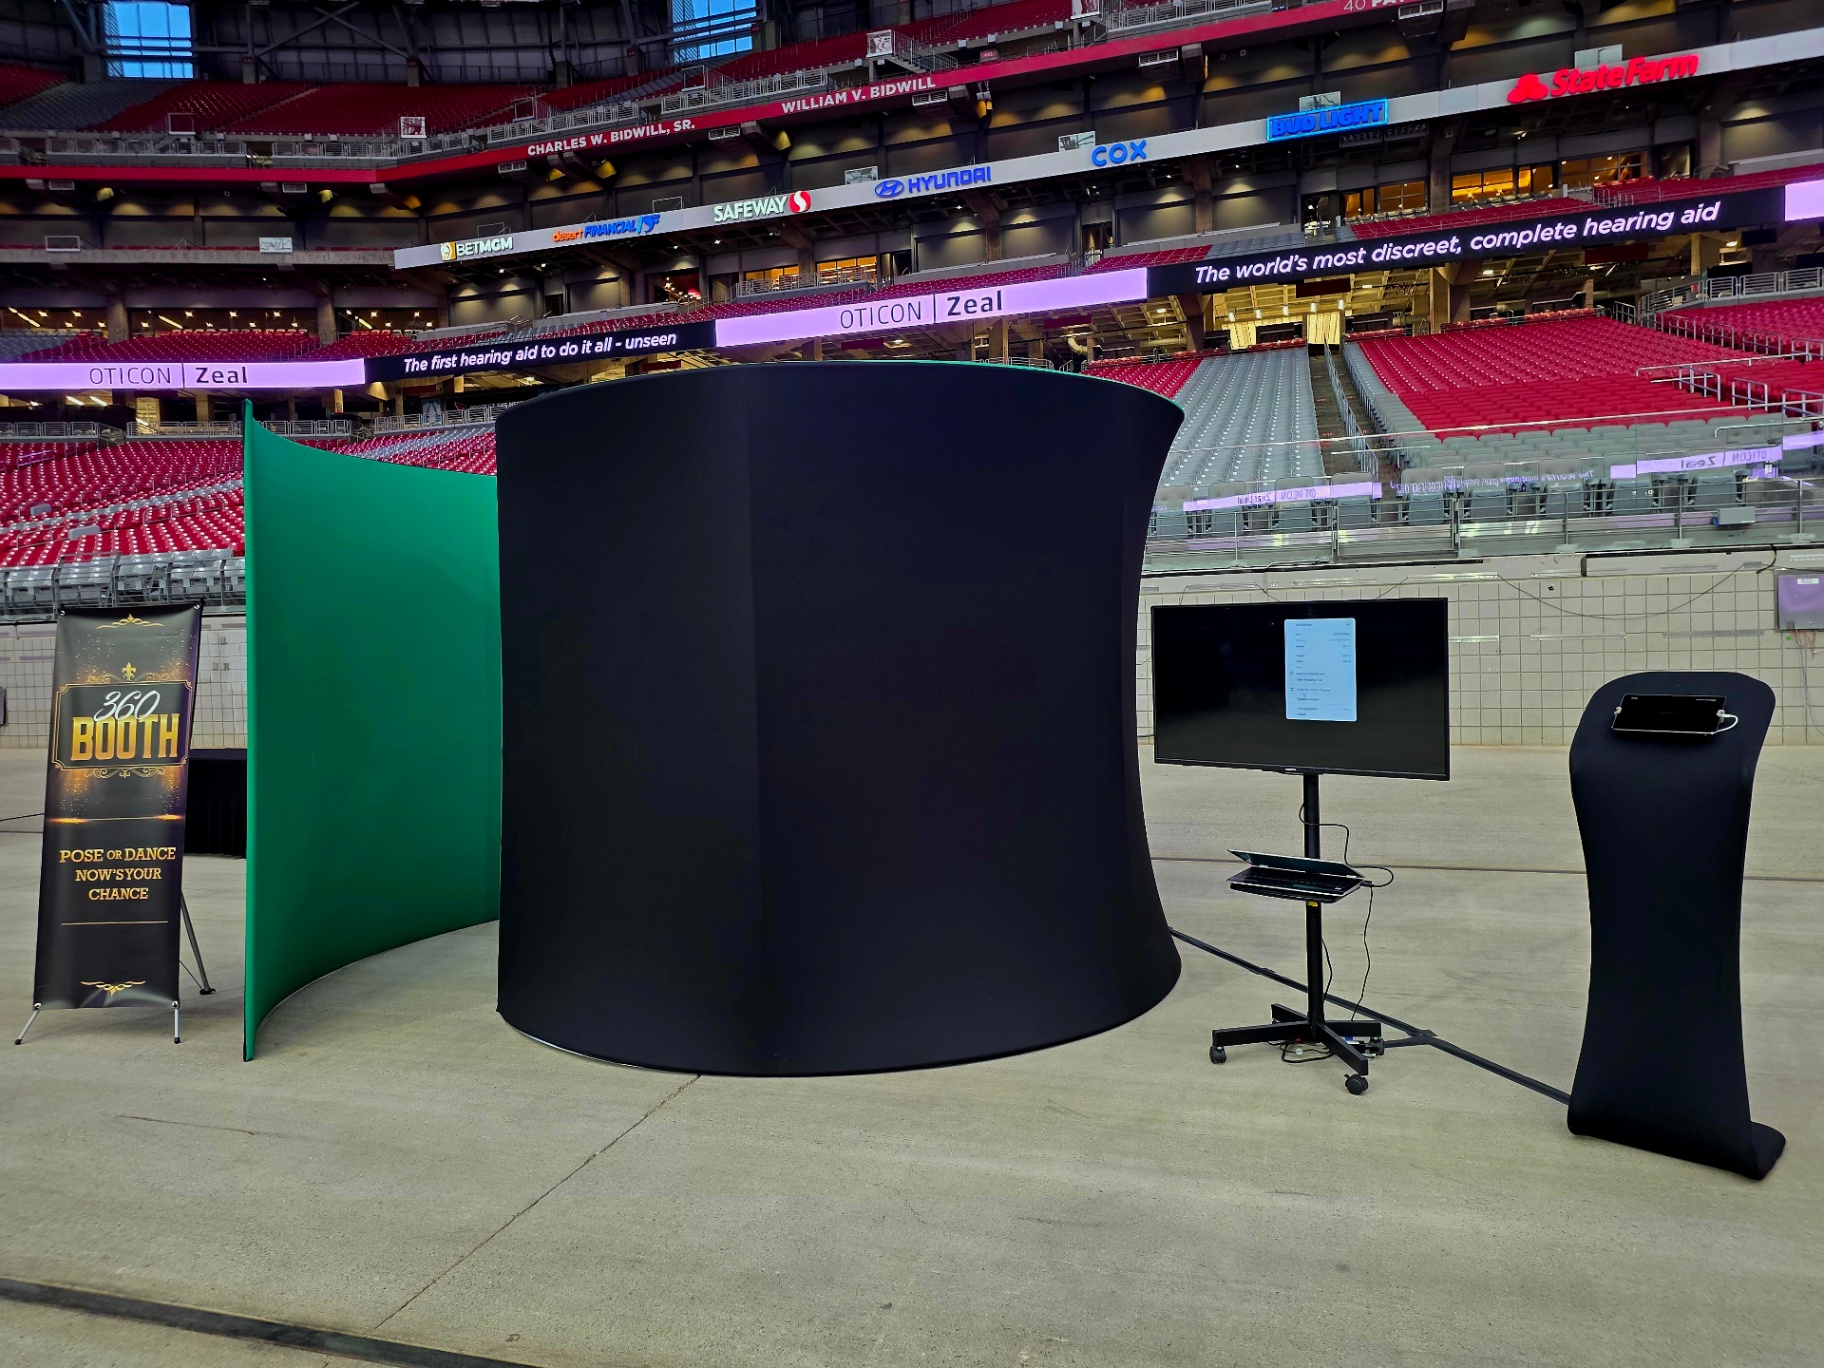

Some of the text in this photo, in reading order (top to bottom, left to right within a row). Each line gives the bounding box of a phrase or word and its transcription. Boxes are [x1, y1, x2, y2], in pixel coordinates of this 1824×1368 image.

[1342, 0, 1366, 12] 40
[781, 77, 936, 113] WILLIAM V. BIDWILL
[1271, 102, 1385, 138] BUD LIGHT
[527, 119, 695, 156] CHARLES W. BIDWILL, SR.
[1091, 139, 1147, 167] COX
[908, 166, 992, 194] HYUNDAI
[713, 195, 788, 223] SAFEWAY
[552, 219, 638, 243] desert FINANCIAL
[1195, 201, 1722, 284] The world's most discreet, complete hearing aid
[456, 236, 514, 257] BETMGM
[840, 290, 1003, 329] OTICON Zeal
[403, 357, 429, 373] The
[431, 355, 458, 370] first
[460, 350, 511, 369] hearing
[516, 348, 538, 362] aid
[541, 345, 556, 358] to
[559, 342, 579, 357] do
[581, 340, 592, 355] it
[595, 337, 613, 352] all
[625, 333, 678, 351] unseen
[89, 366, 249, 385] OTICON Zeal
[93, 690, 161, 722] 360
[70, 713, 180, 761] BOOTH
[59, 846, 177, 864] POSE OR DANCE
[75, 867, 162, 882] NOW'S YOUR
[88, 887, 149, 901] CHANCE
